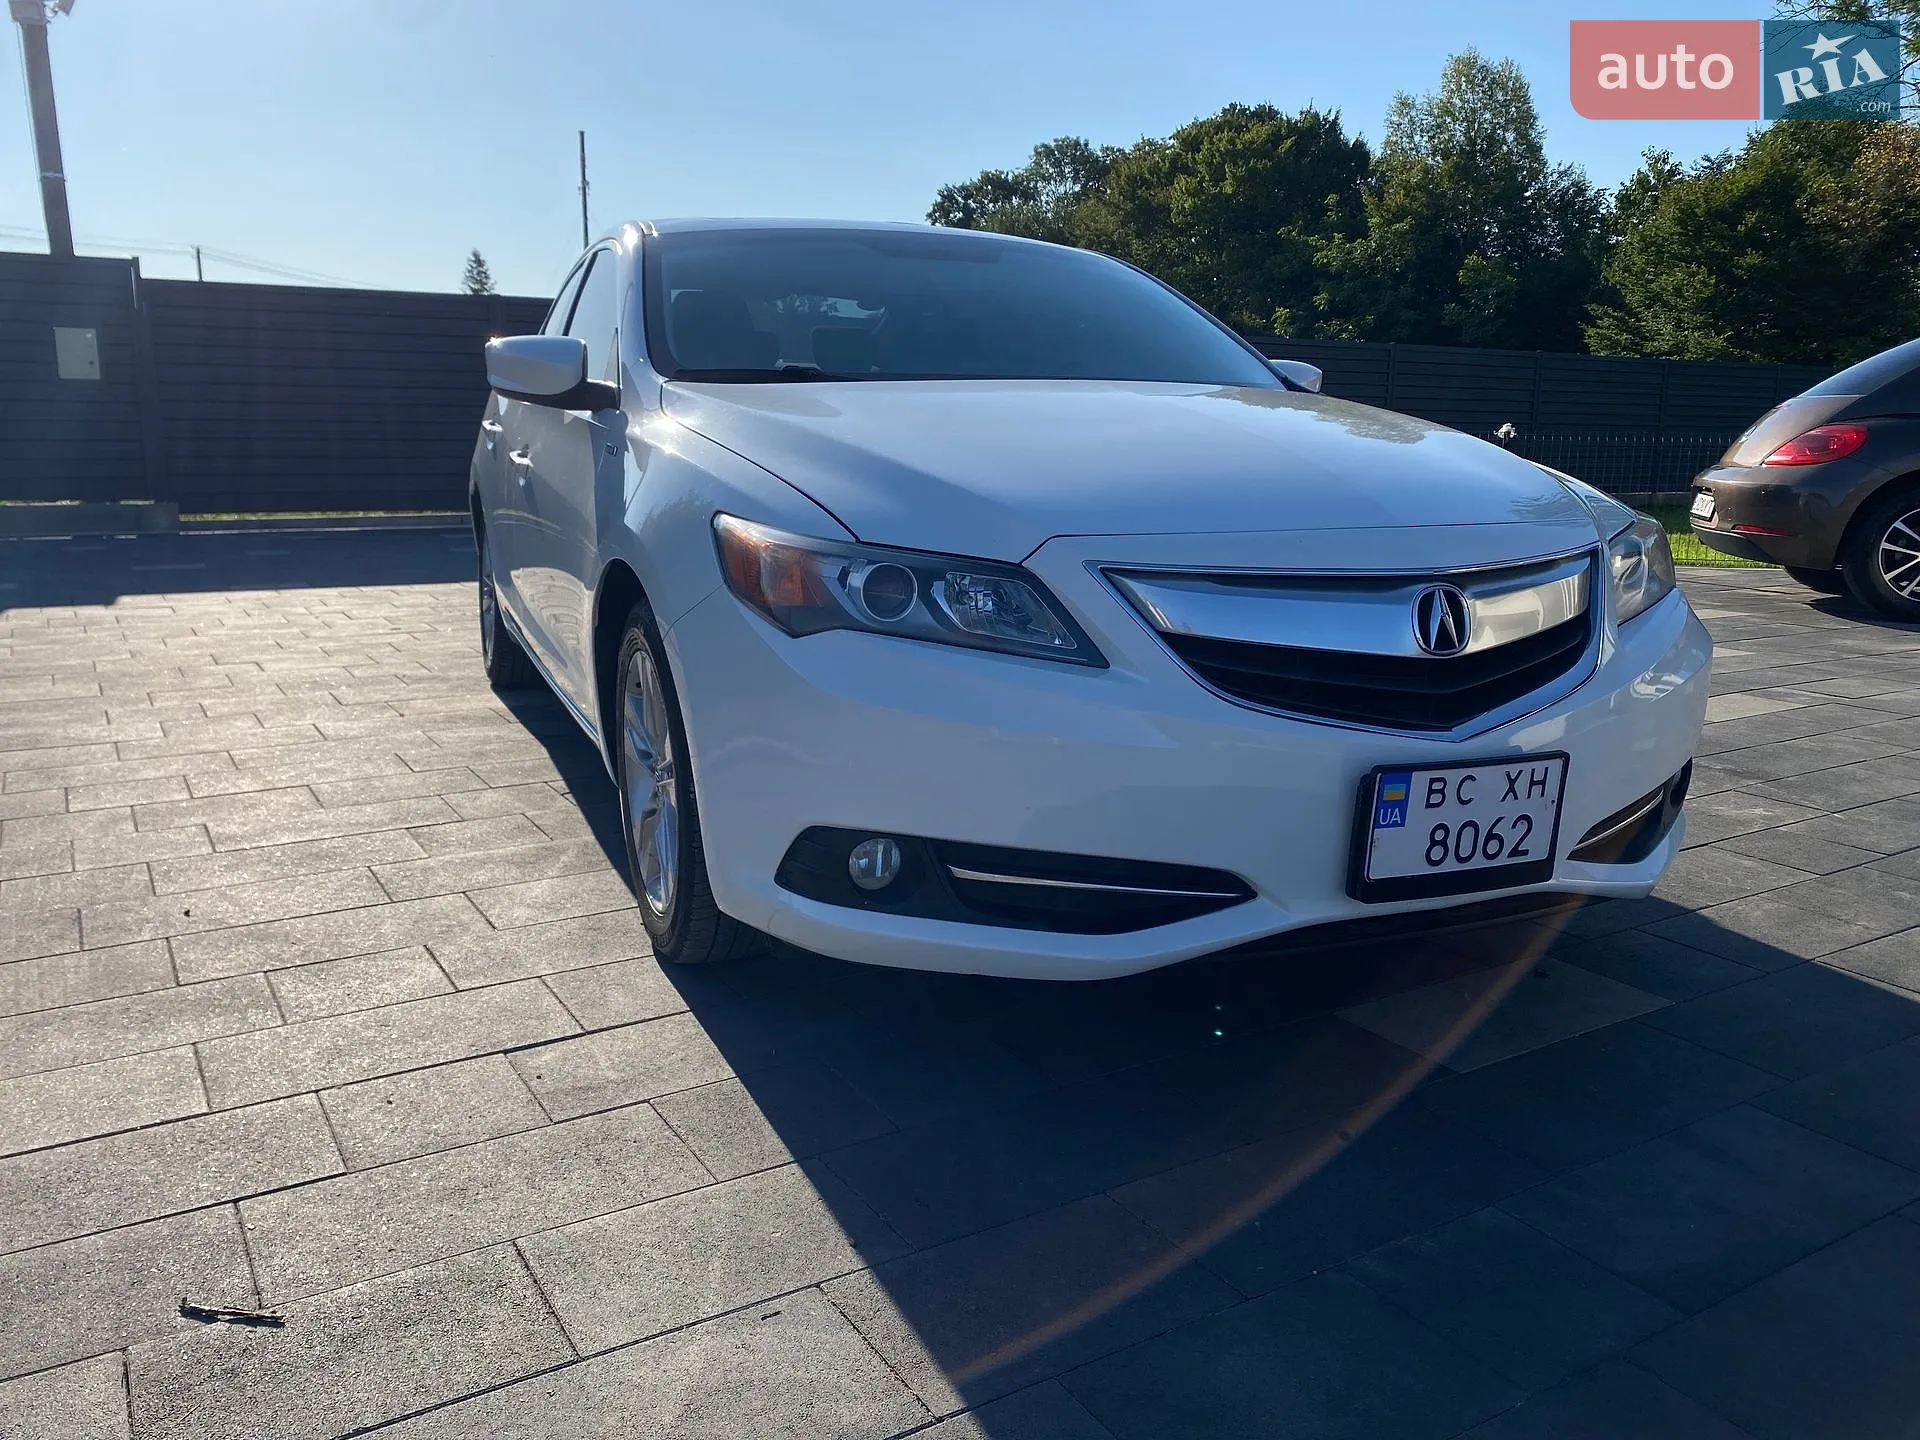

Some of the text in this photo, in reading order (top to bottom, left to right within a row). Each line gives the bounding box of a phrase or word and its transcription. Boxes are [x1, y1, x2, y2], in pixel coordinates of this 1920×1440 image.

[1424, 766, 1549, 809] BC XH
[1379, 808, 1401, 825] UA
[1424, 813, 1534, 867] 8062
